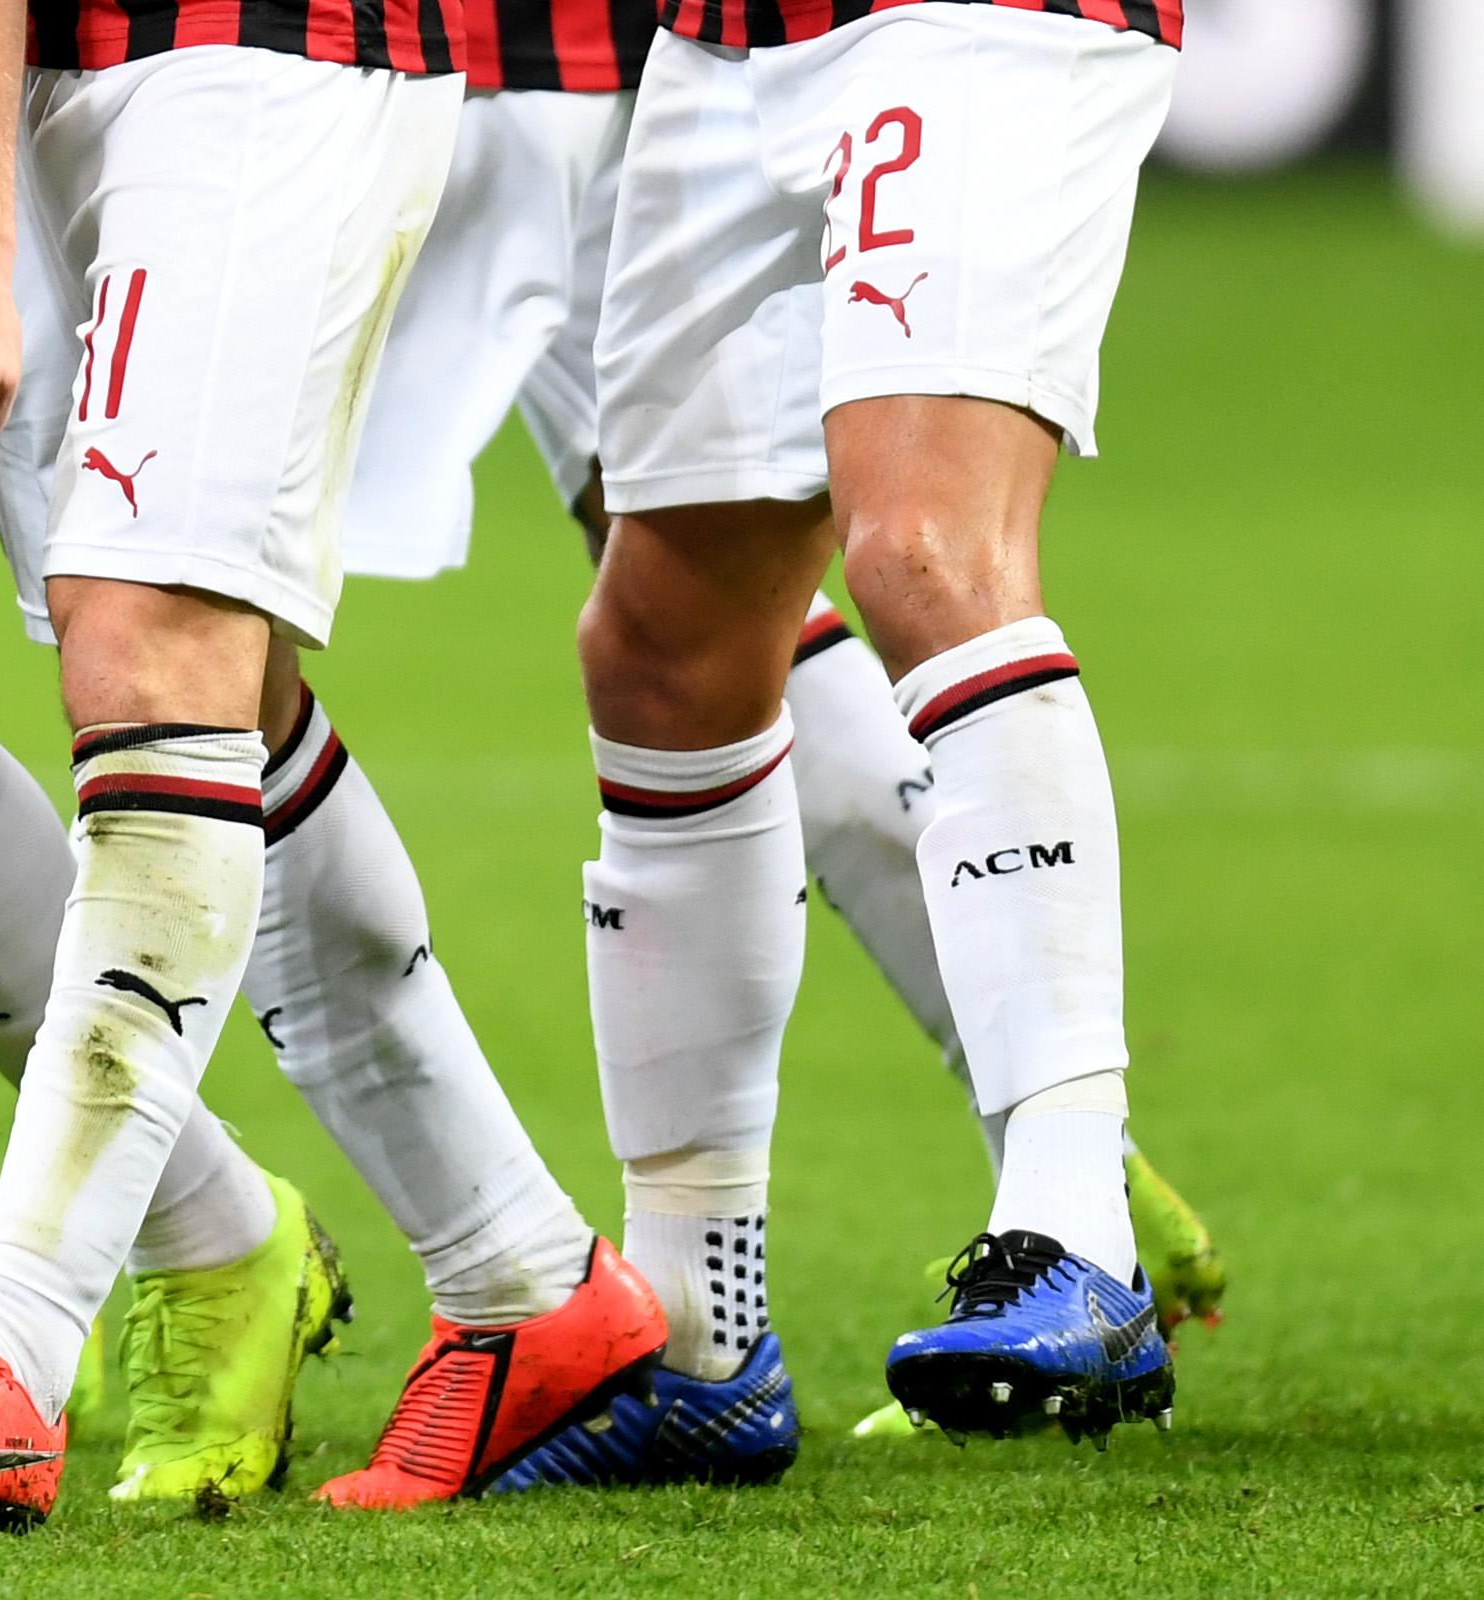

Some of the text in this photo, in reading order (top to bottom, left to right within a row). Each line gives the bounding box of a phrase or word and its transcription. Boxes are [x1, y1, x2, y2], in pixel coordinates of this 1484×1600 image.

[821, 106, 922, 271] 22
[78, 268, 147, 422] 11
[951, 841, 1075, 888] ACM
